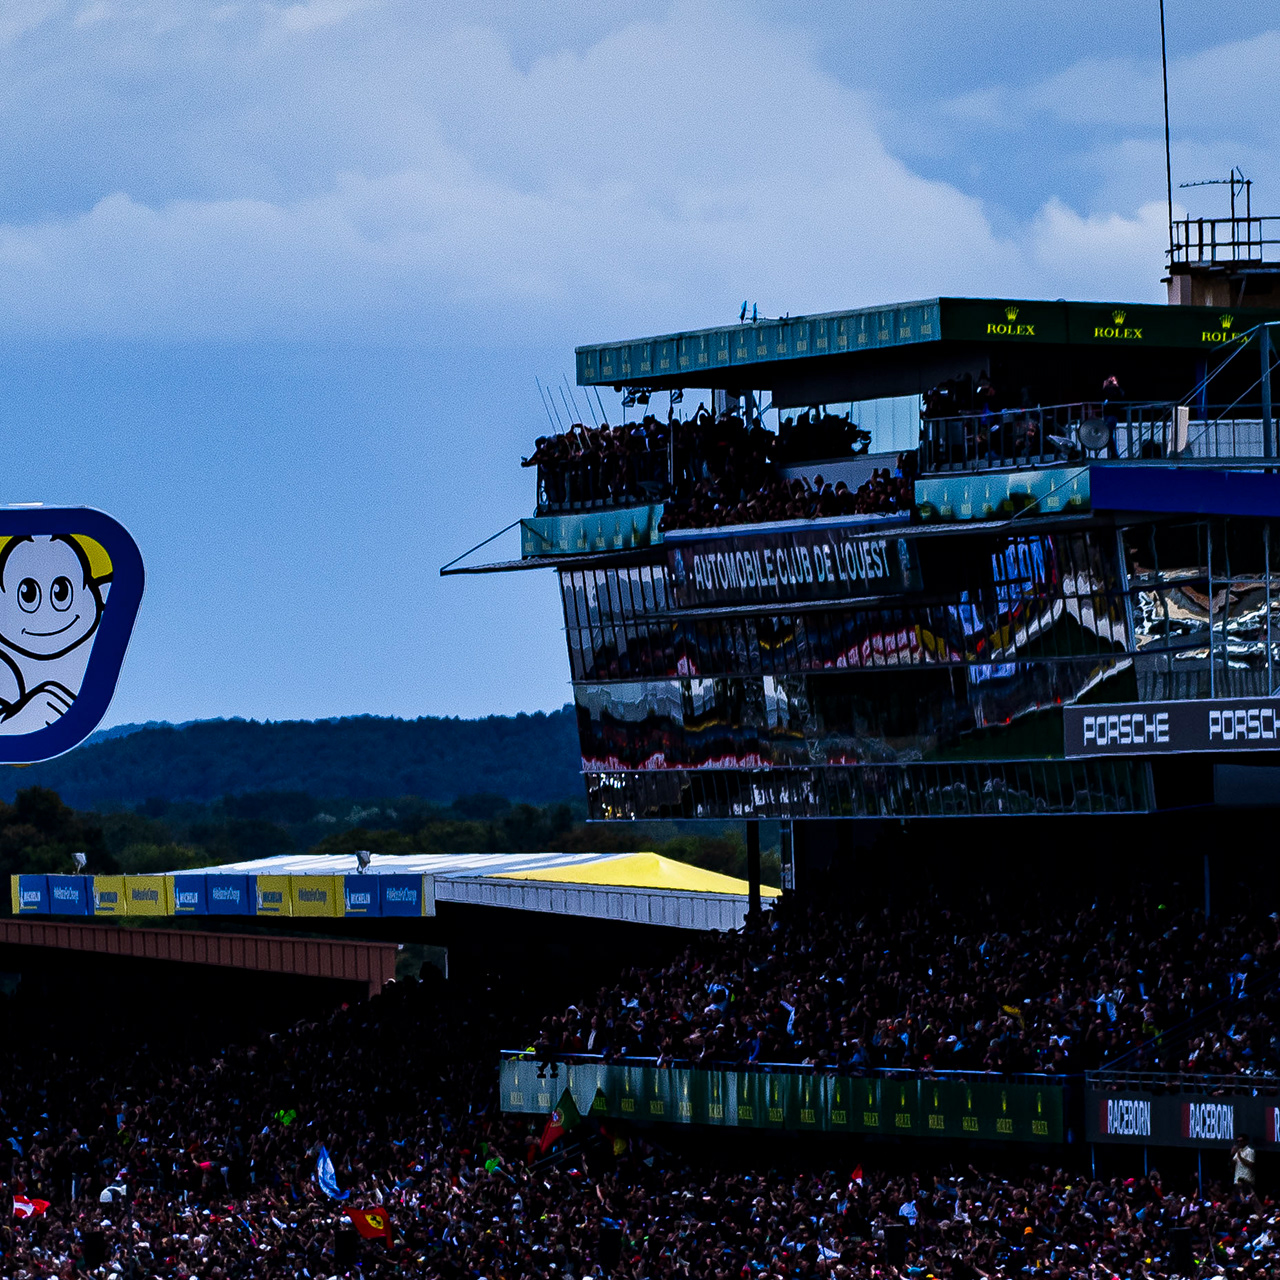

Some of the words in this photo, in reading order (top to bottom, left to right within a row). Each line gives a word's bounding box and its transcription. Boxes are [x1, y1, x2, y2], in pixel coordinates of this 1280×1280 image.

[986, 323, 1035, 336] ROLEX
[1094, 327, 1143, 339] ROLEX
[692, 549, 775, 590] AUTOMOBILE
[774, 547, 812, 585] CLUB
[811, 544, 834, 583] DE
[832, 539, 889, 582] L'OUEST
[1083, 712, 1170, 746] PORSCHE
[1107, 1100, 1151, 1136] RACEBORN
[1189, 1102, 1234, 1140] RACEBORN
